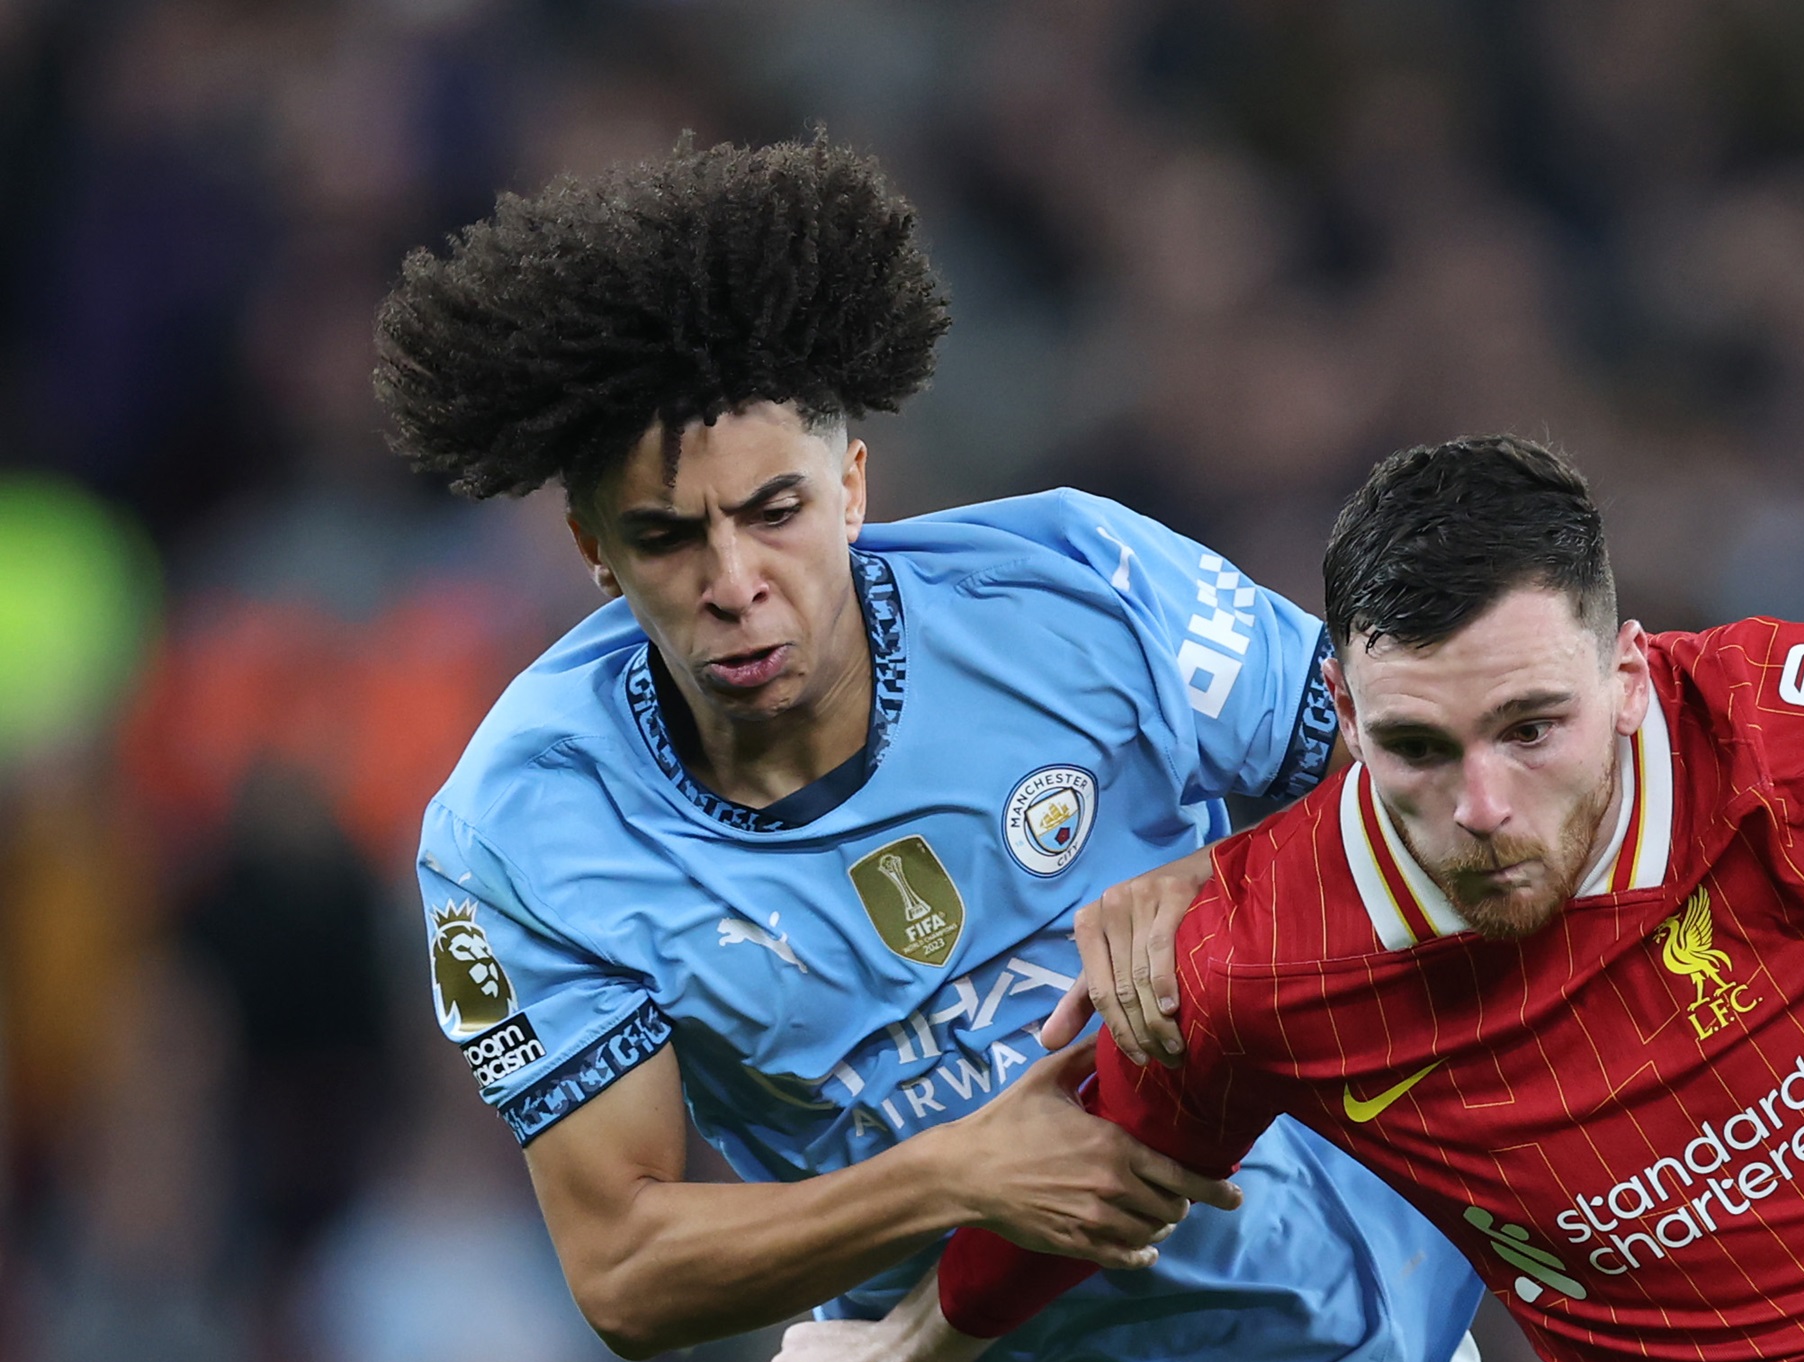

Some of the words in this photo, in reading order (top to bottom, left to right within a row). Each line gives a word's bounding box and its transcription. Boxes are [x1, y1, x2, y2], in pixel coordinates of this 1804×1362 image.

[1010, 773, 1088, 828] MANCHESTER
[1057, 841, 1078, 866] CITY
[905, 913, 946, 942] FIFA
[922, 937, 946, 956] 2023
[1687, 984, 1763, 1041] L.F.C.
